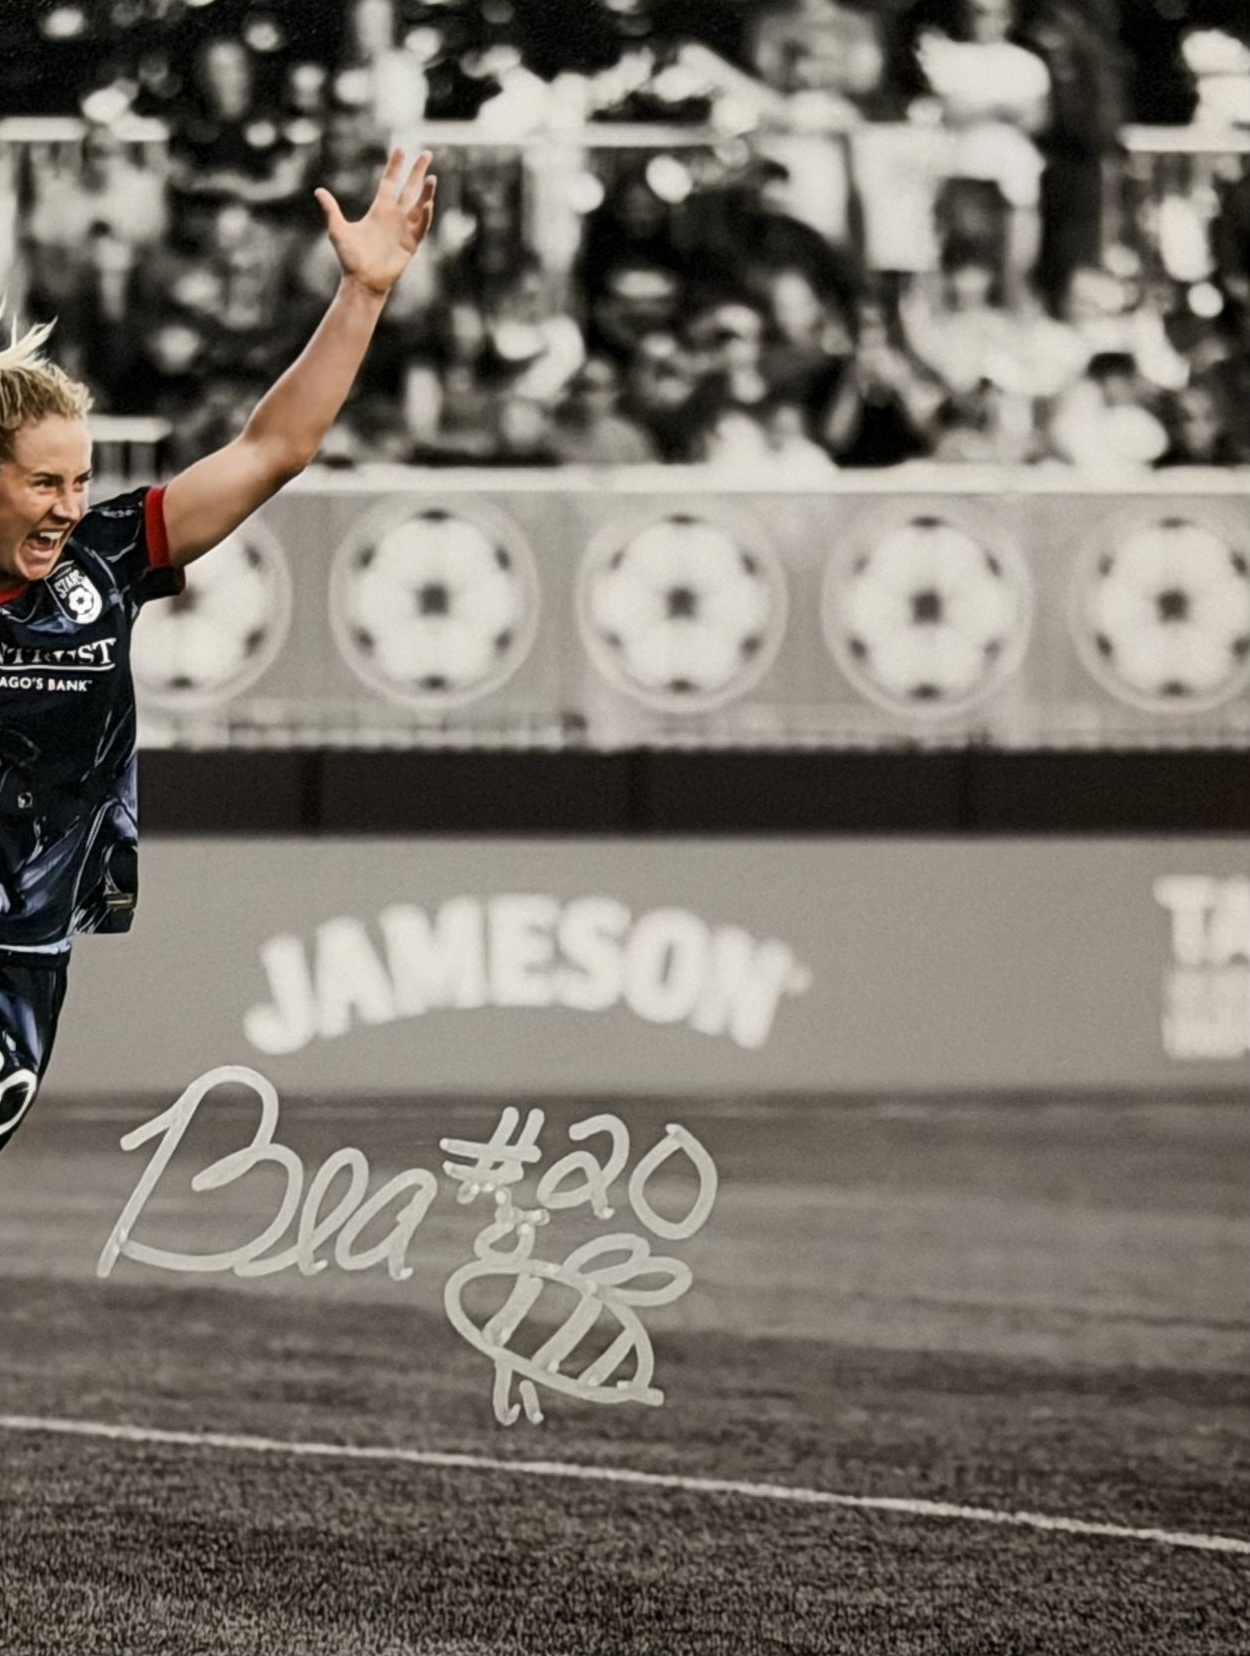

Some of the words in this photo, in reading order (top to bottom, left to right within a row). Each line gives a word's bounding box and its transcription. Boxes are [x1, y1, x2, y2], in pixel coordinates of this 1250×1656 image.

[243, 893, 794, 1055] JAMESON
[96, 1065, 438, 1281] Bea
[440, 1106, 718, 1240] #20
